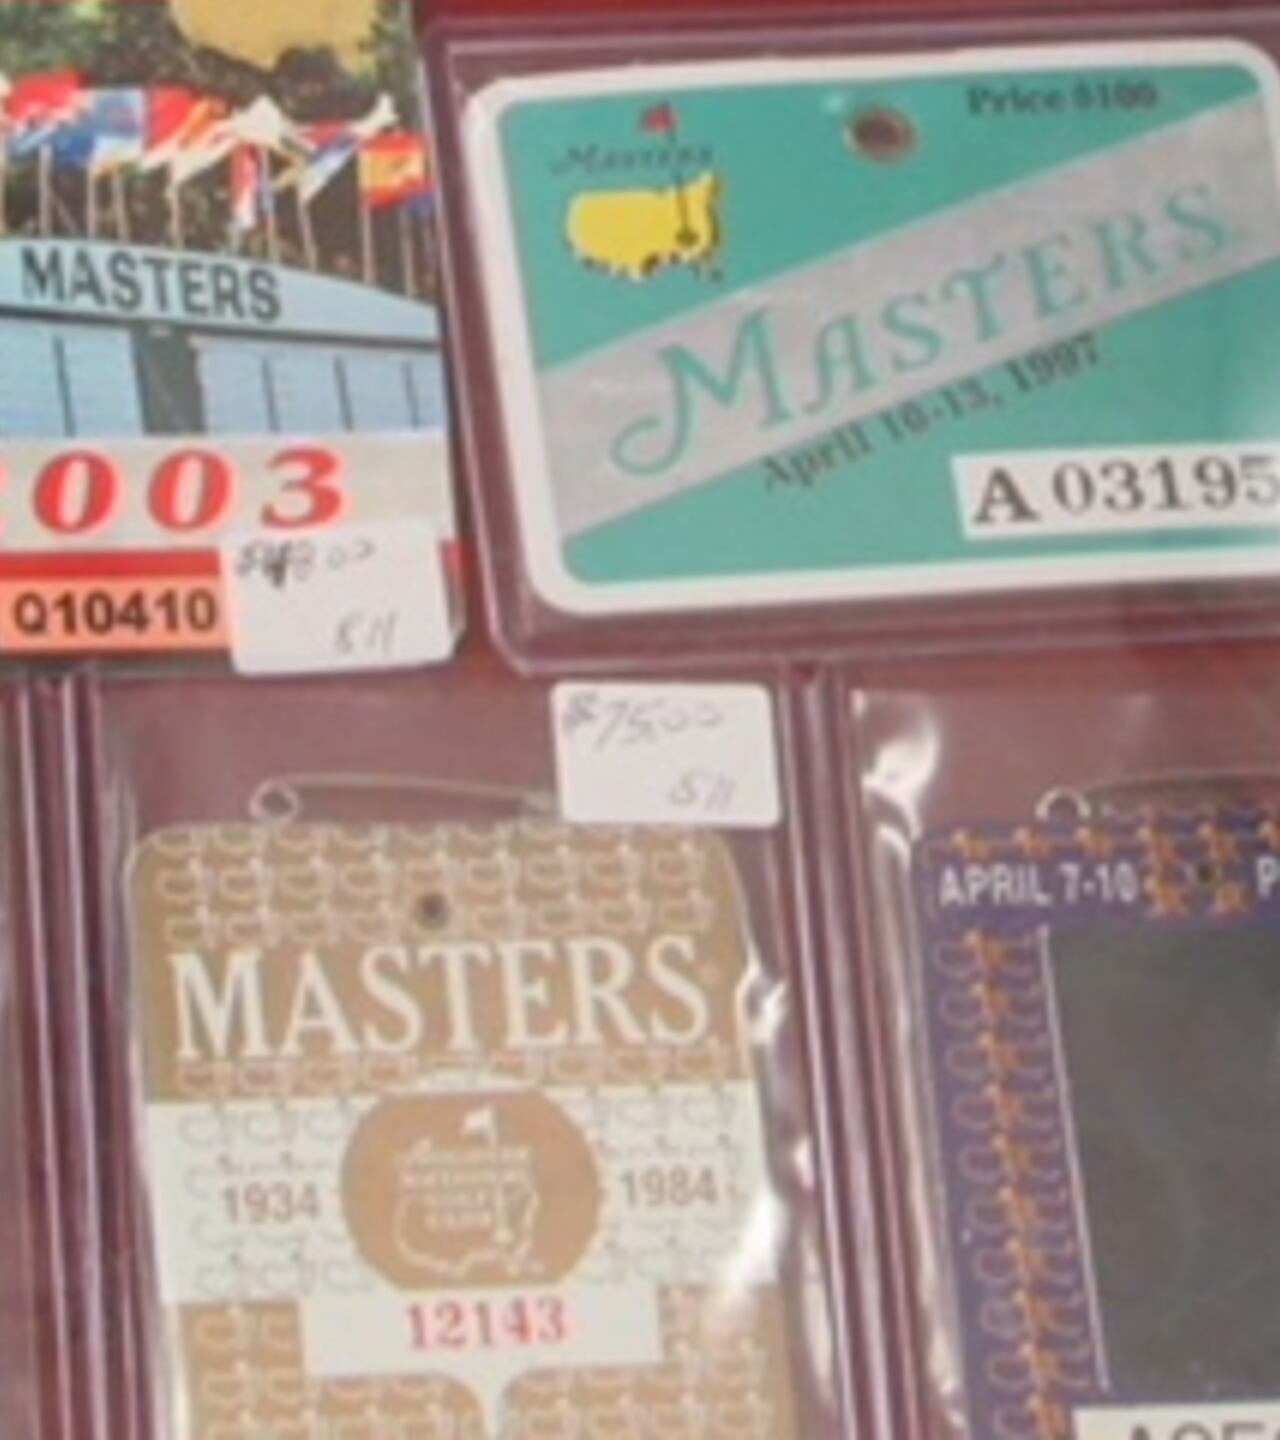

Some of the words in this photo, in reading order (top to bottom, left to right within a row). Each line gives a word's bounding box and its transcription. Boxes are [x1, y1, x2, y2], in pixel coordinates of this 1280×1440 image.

[966, 82, 1065, 114] Price
[22, 246, 281, 323] MASTERS
[609, 183, 1242, 477] MASTERS
[758, 427, 876, 492] April
[973, 466, 1041, 525] A
[13, 587, 220, 637] Q10410
[938, 864, 1052, 906] APRIL
[1061, 861, 1139, 902] 7-10
[170, 934, 710, 1059] MASTERS
[222, 1181, 320, 1225] 1934
[619, 1168, 718, 1208] 1984
[406, 1298, 569, 1349] 12143
